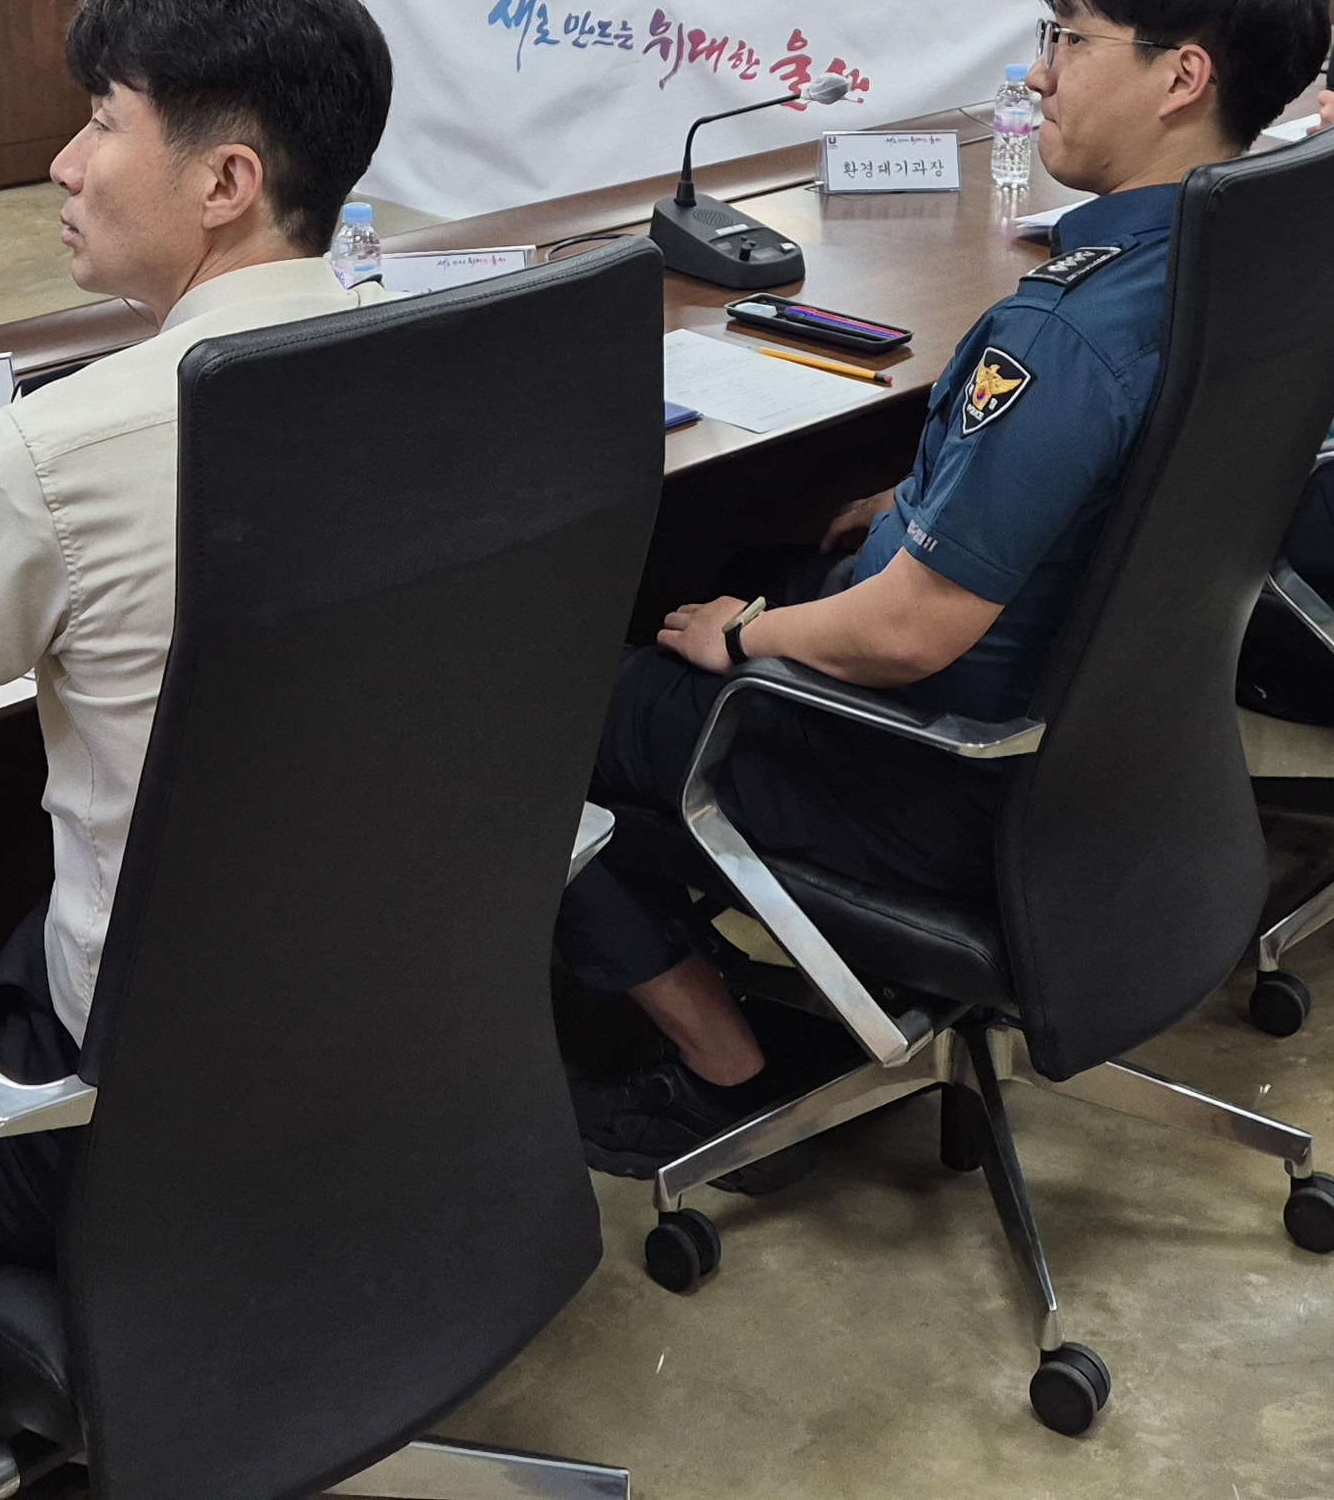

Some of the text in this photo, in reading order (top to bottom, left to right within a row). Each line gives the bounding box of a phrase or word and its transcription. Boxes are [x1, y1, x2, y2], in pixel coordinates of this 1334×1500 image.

[563, 10, 635, 50] 만드는
[642, 8, 761, 91] 위대한
[843, 159, 944, 179] 환경대기과장
